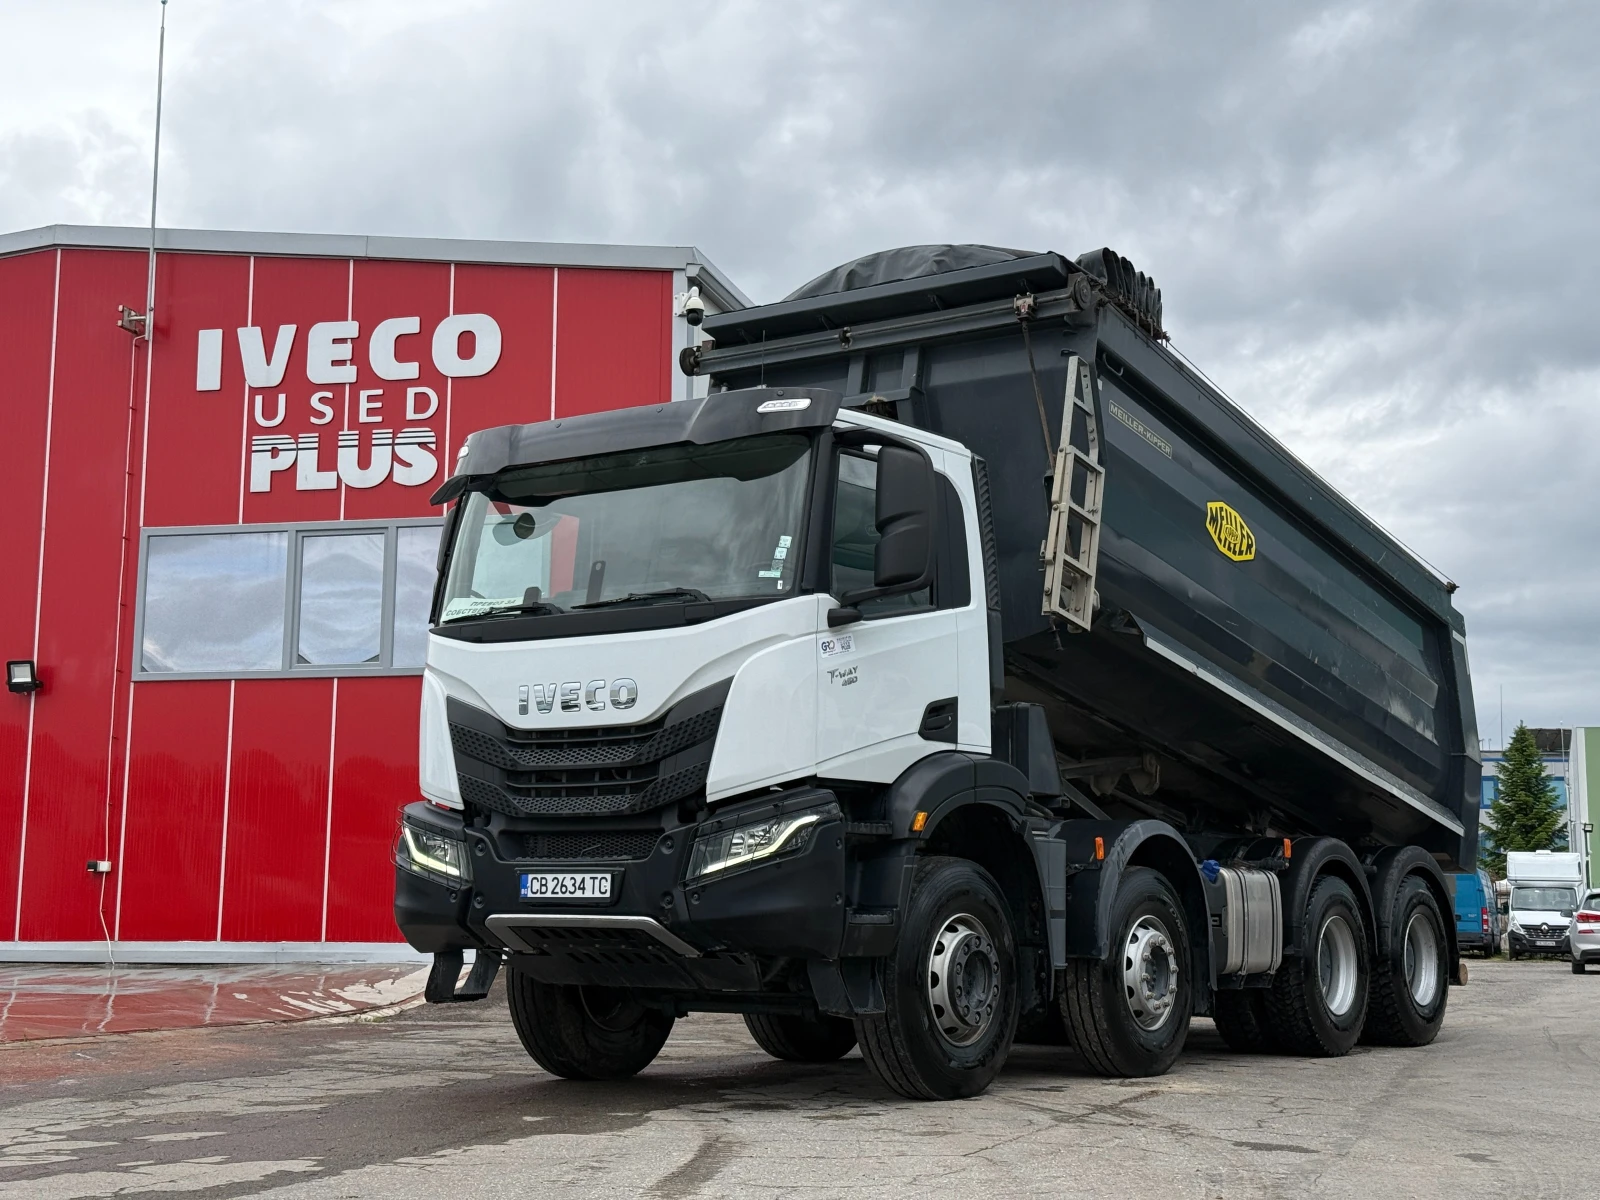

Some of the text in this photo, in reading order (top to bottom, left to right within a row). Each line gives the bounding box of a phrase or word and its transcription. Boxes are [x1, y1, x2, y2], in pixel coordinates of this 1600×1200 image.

[196, 313, 502, 391] IVECO
[254, 386, 439, 428] USED
[1110, 403, 1171, 455] MEILLER-KIPPER
[250, 427, 438, 492] PLUS
[1208, 505, 1255, 557] MEILLER
[519, 677, 638, 715] IVECO
[827, 665, 858, 684] T-WAY
[530, 876, 548, 895] CB
[551, 876, 586, 895] 2634
[589, 876, 608, 895] TC
